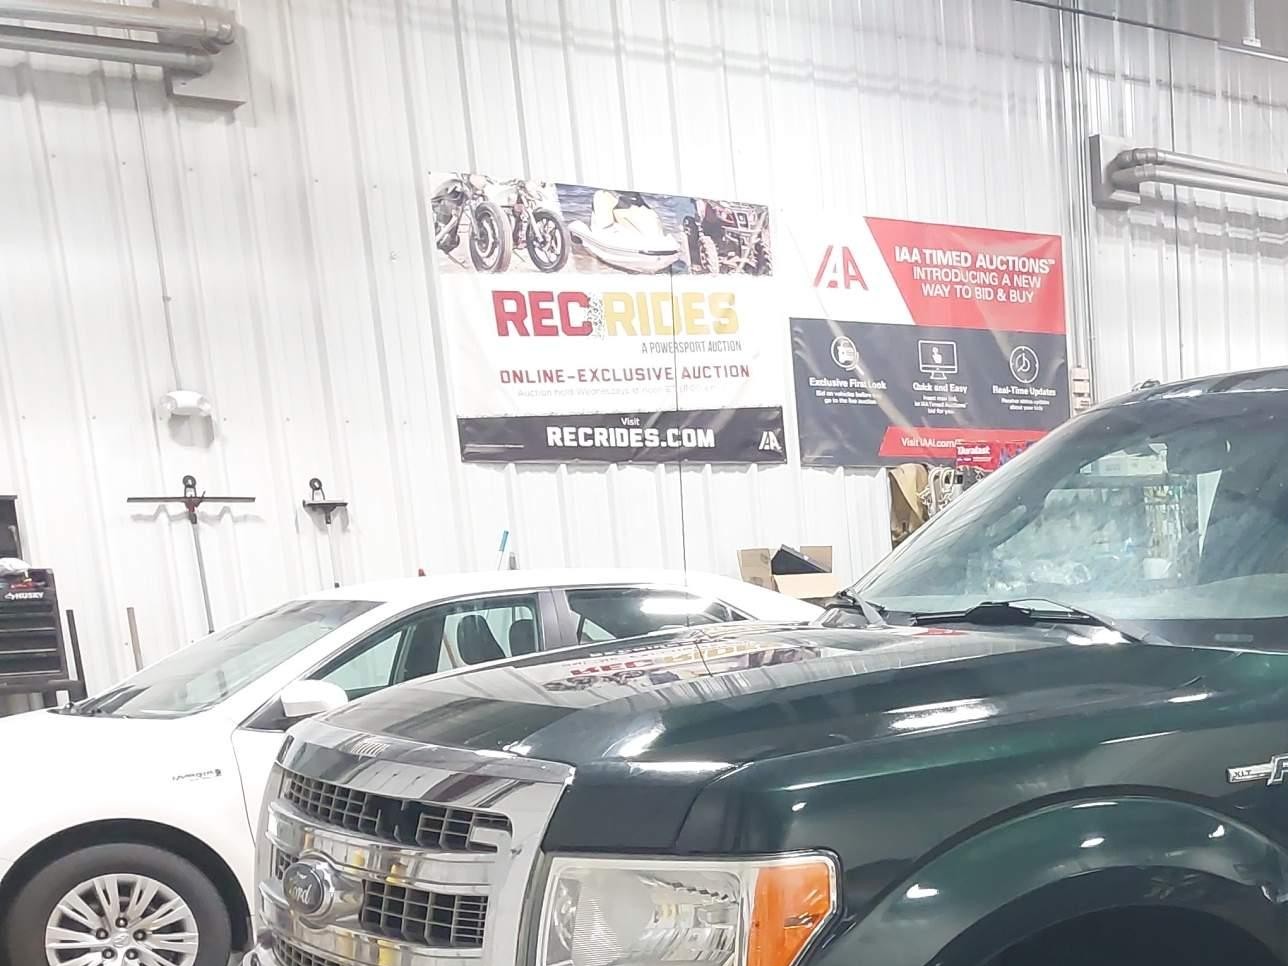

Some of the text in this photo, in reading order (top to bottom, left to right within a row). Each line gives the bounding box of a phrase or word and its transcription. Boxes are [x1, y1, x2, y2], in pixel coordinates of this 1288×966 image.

[895, 245, 921, 263] IAA
[922, 248, 972, 267] TIMED
[913, 266, 1041, 288] INTRODUCING A NEW
[922, 283, 1034, 303] WAY TO BID & BUY
[491, 290, 739, 337] REC RIDES
[641, 339, 742, 354] A POWERSPORT AUCTION
[500, 365, 750, 384] ONLINE-EXCLUSIVE AUCTION
[809, 377, 848, 388] Exclusive
[912, 382, 968, 394] Quick and Easy
[992, 385, 1056, 397] Real-Time Updates
[620, 417, 640, 426] Visit
[546, 426, 716, 448] RECRIDES.COM
[901, 437, 919, 447] Visit
